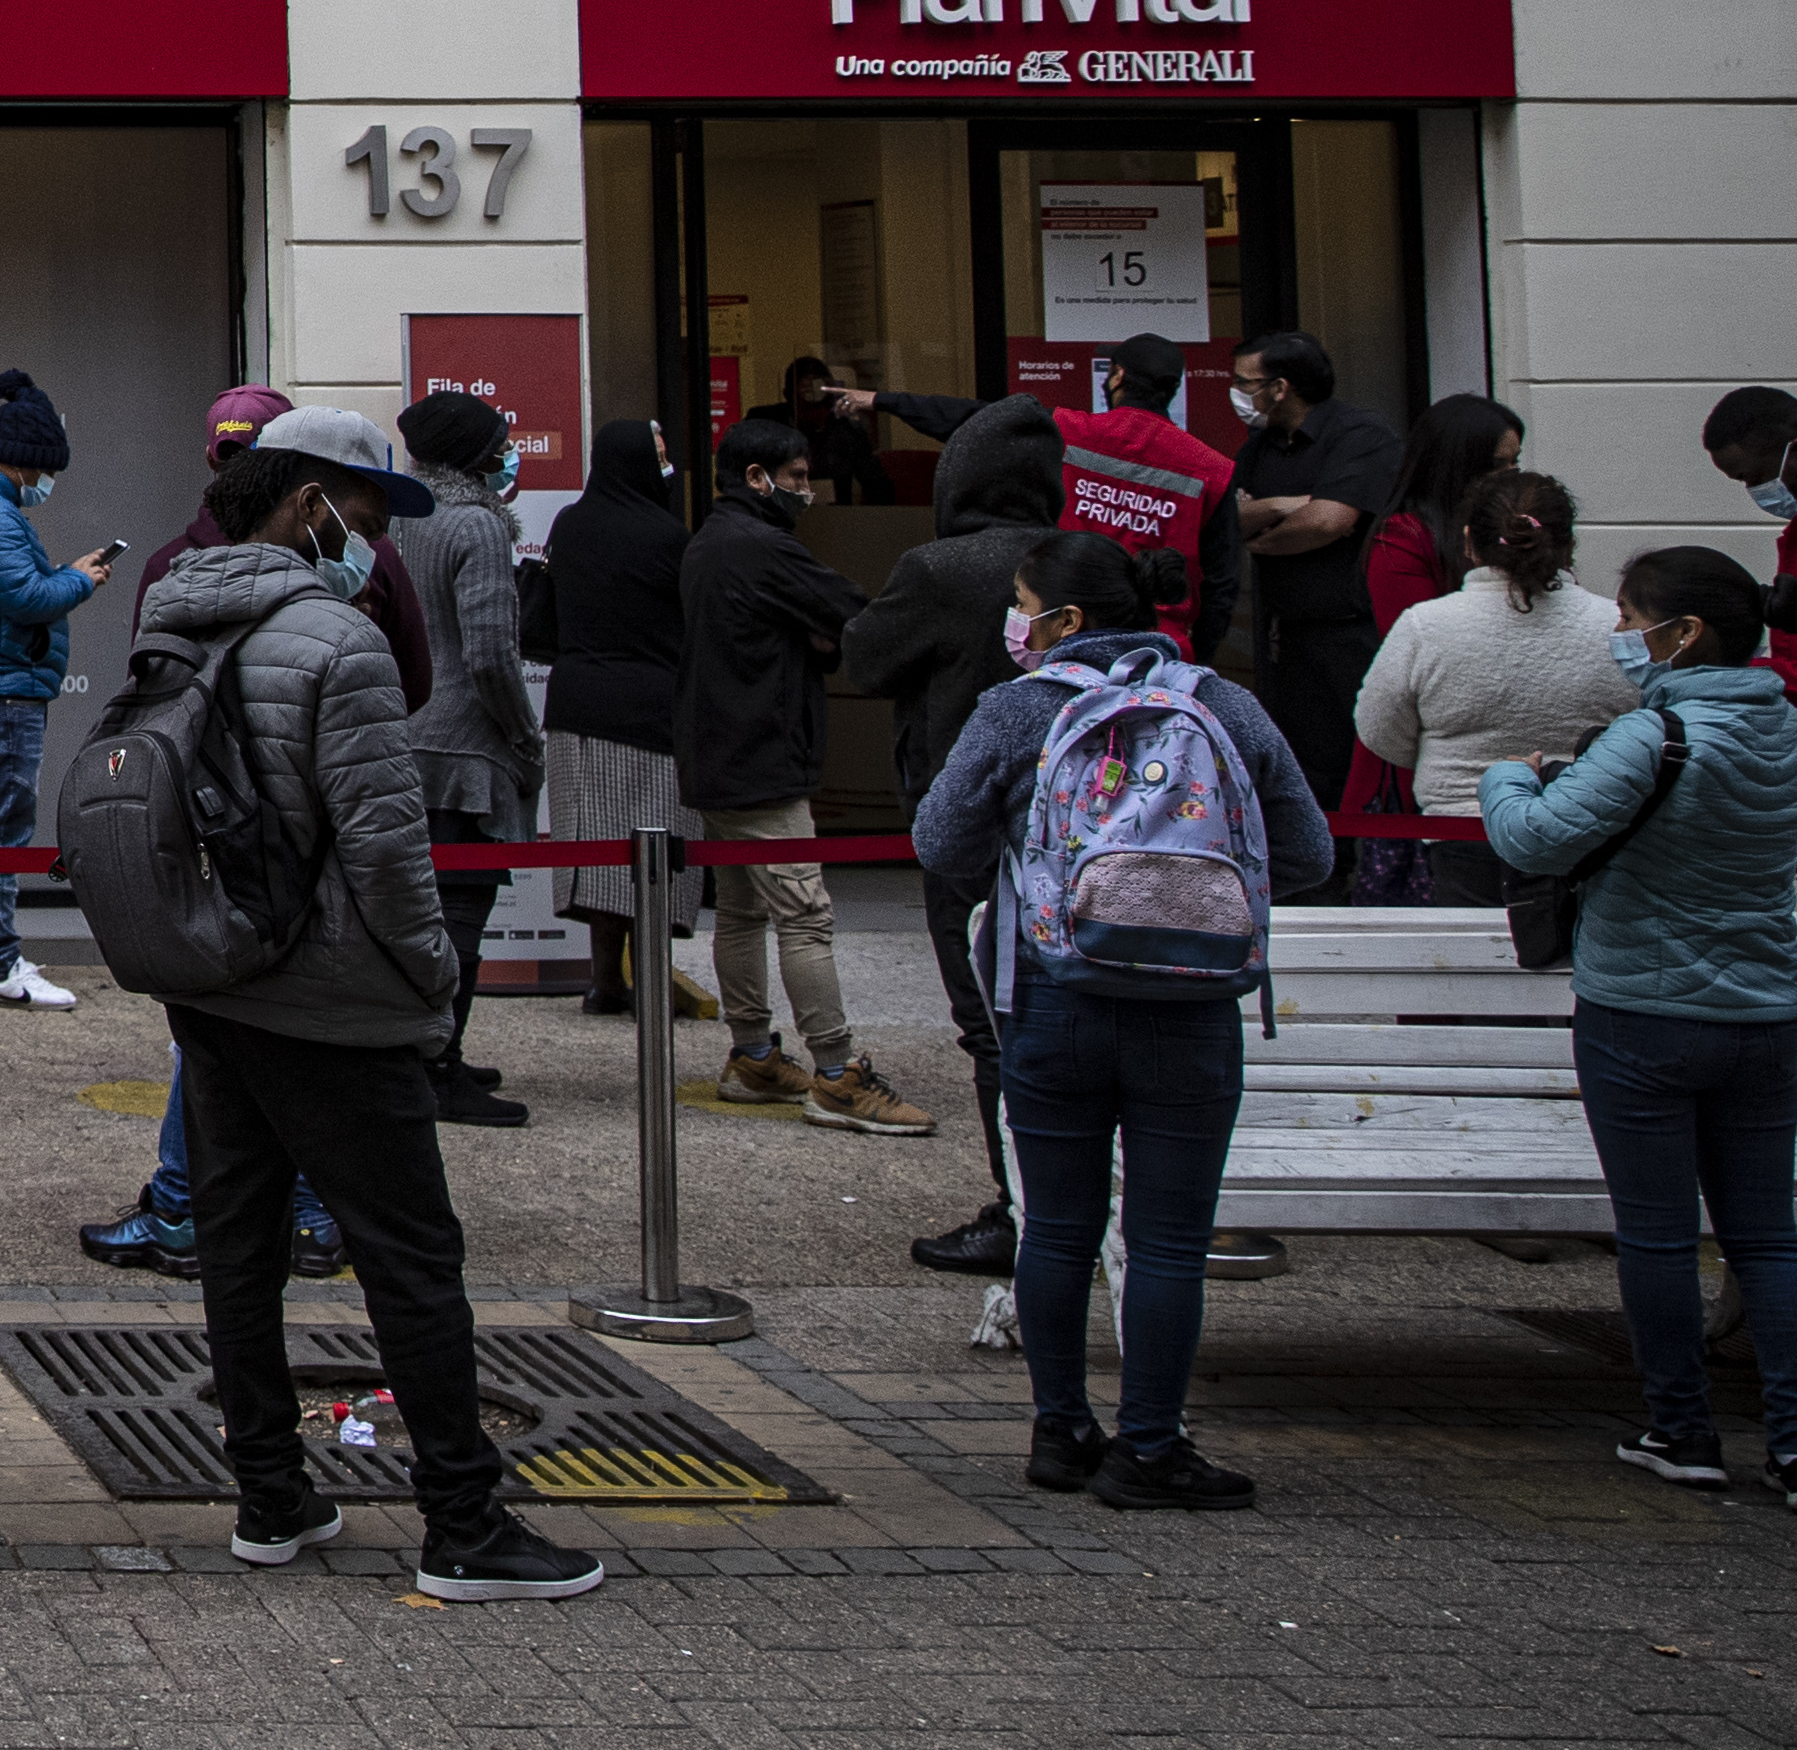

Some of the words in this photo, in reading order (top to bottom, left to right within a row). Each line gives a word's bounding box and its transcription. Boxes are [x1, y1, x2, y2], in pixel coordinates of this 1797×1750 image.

[835, 55, 886, 78] Una
[890, 54, 1012, 83] compañía
[1078, 50, 1256, 84] GENERALI
[345, 124, 533, 218] 137
[1099, 251, 1147, 287] 15
[1018, 360, 1060, 371] Horarios
[1062, 360, 1074, 371] de
[1018, 370, 1061, 381] atención
[1194, 368, 1215, 379] 17:30
[470, 377, 497, 397] de
[1074, 478, 1178, 519] SEGURIDAD
[1074, 499, 1161, 537] PRIVADA
